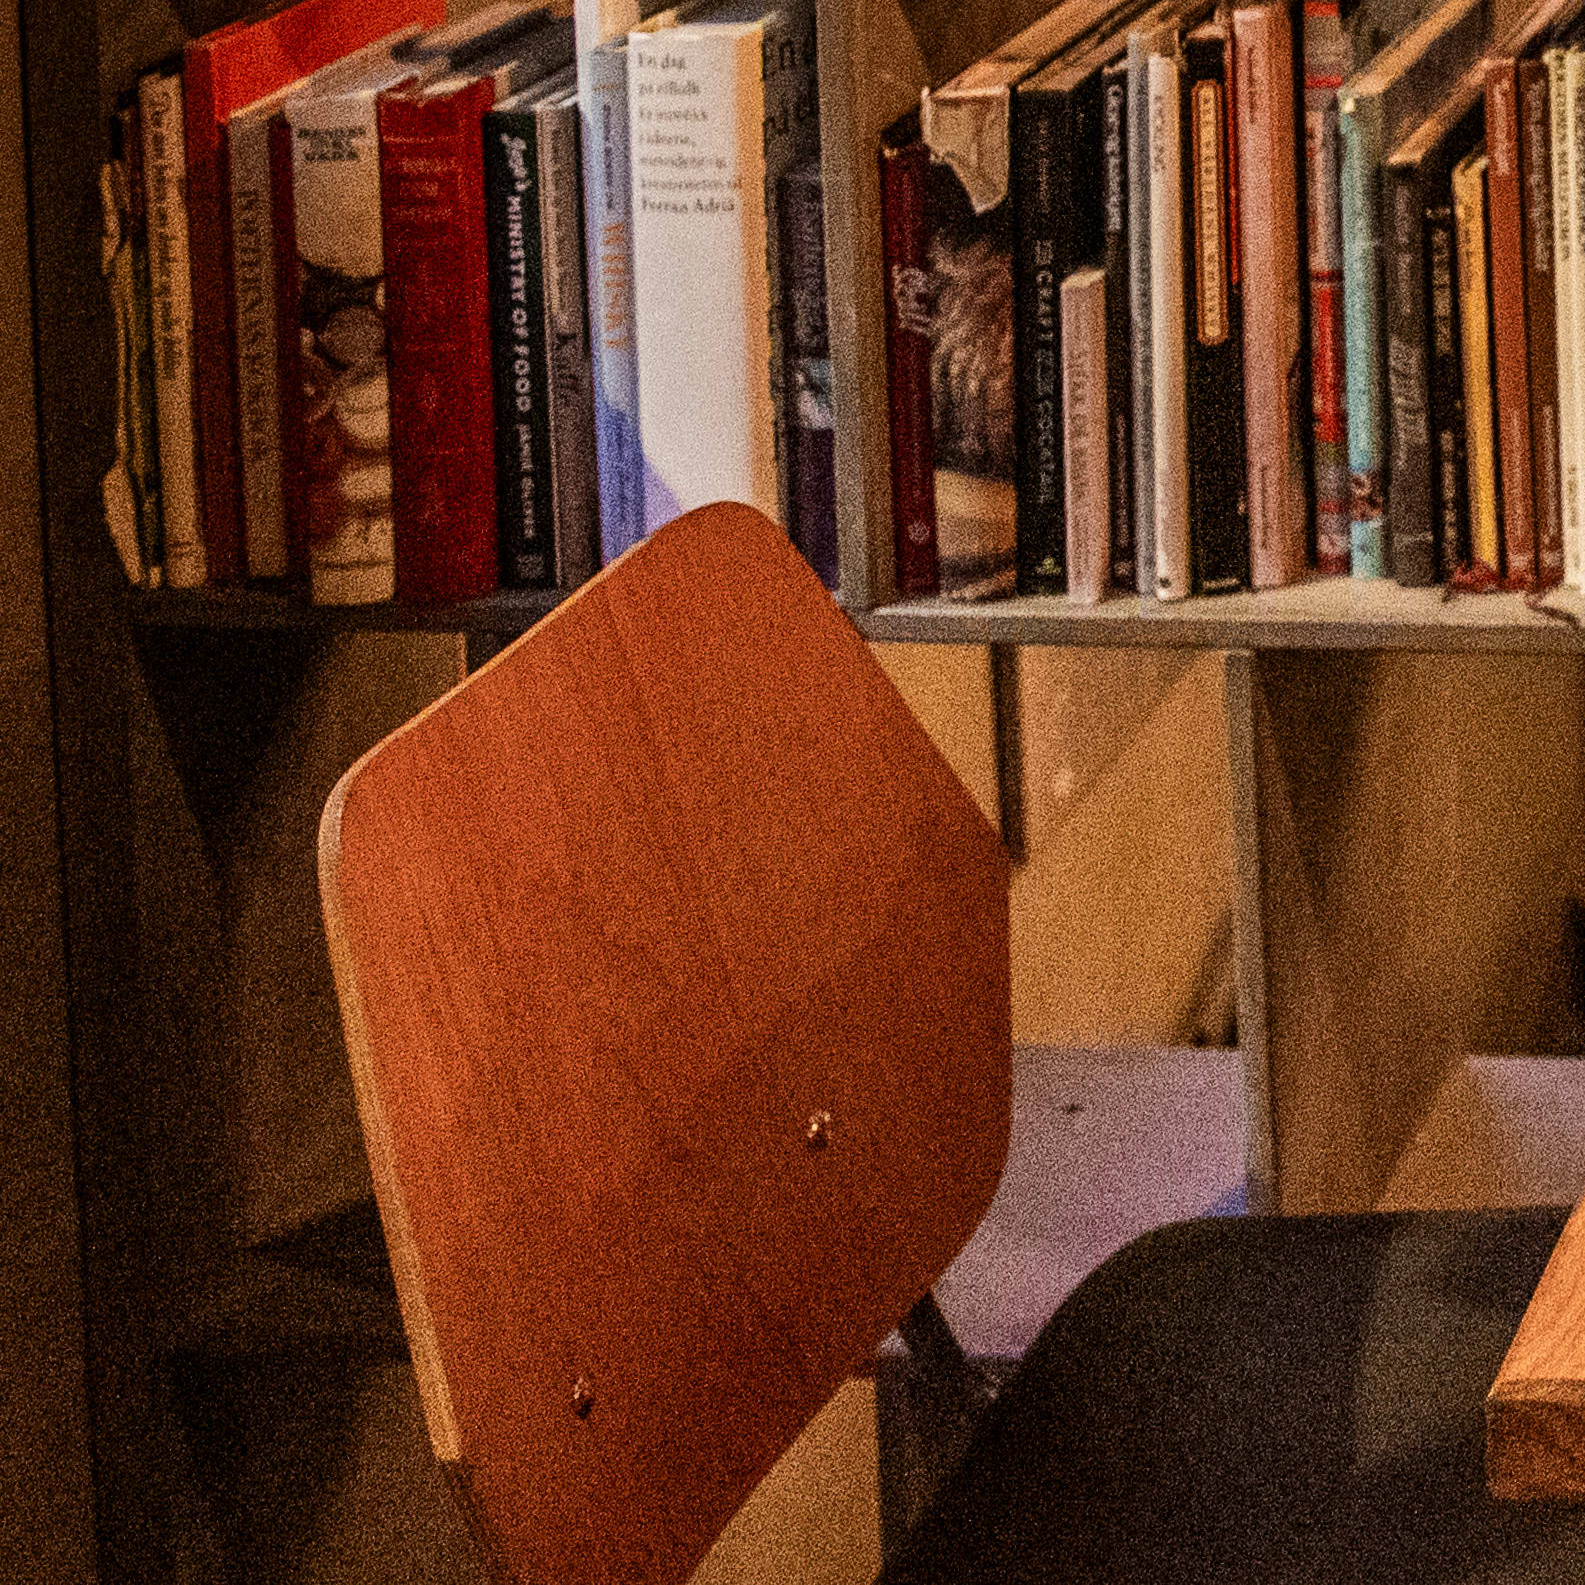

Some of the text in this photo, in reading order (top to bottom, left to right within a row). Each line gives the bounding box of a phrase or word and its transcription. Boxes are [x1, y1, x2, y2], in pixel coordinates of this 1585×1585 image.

[638, 54, 686, 72] En dag
[641, 197, 688, 213] Ferran
[504, 194, 528, 300] MINISTRY
[510, 307, 527, 338] OF
[601, 219, 628, 352] WHISKY
[1036, 267, 1054, 341] CRAFT
[511, 345, 531, 412] FOOD
[514, 423, 538, 538] JAMIE OLIVER
[1037, 397, 1056, 504] COCKTAIL
